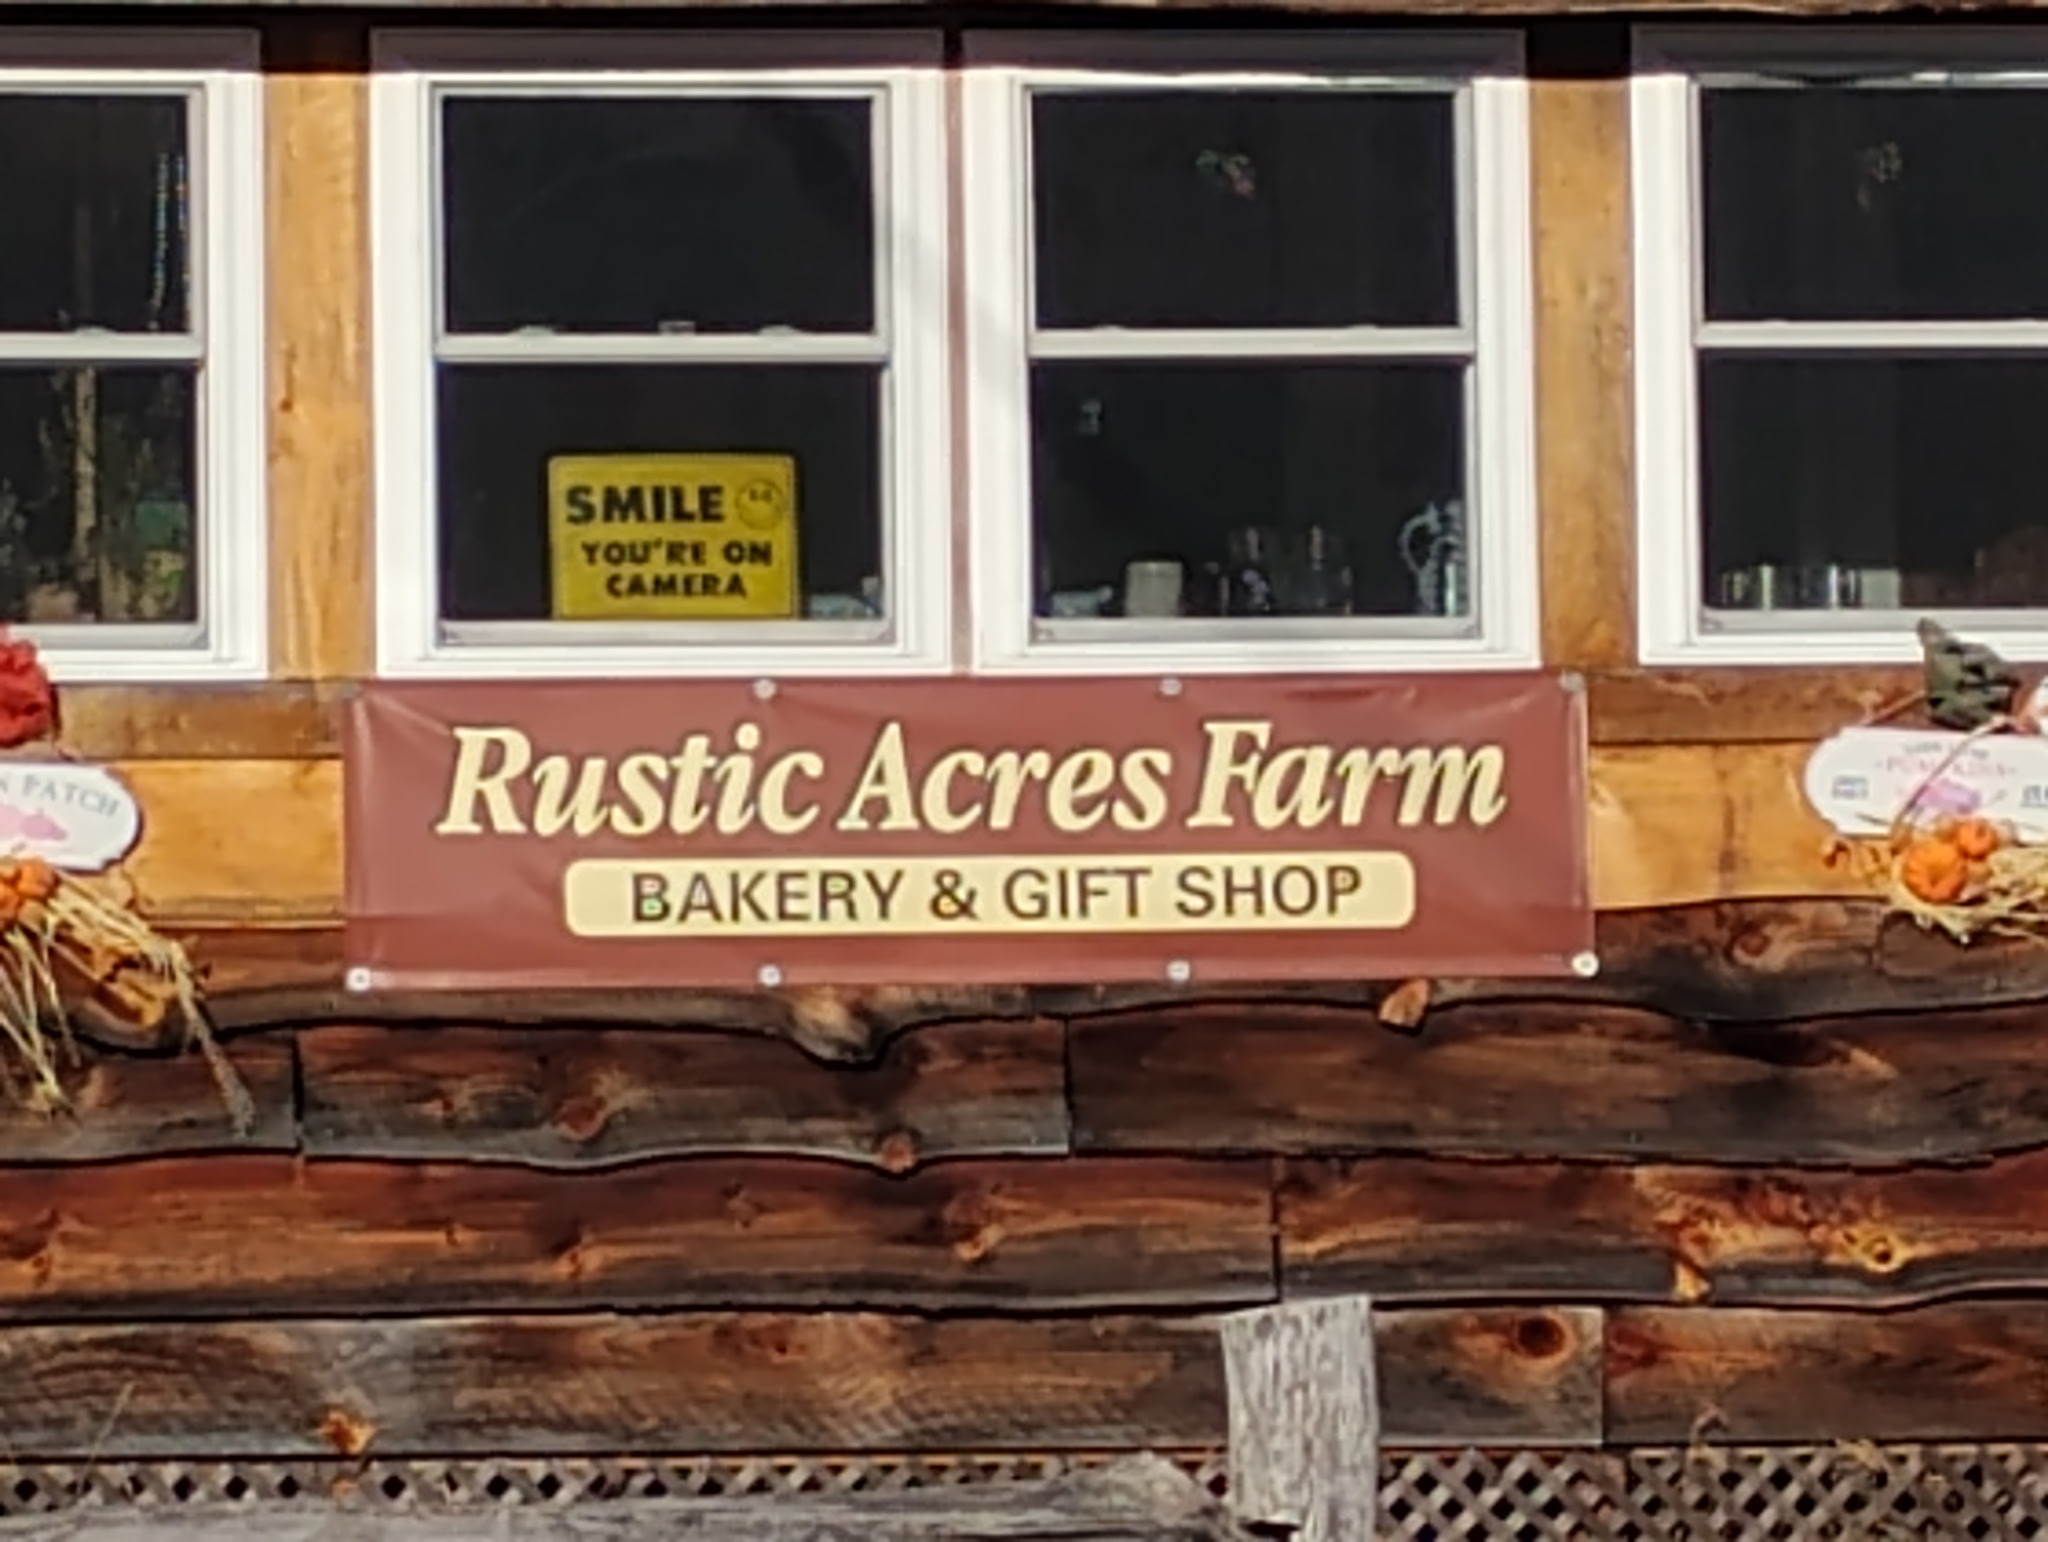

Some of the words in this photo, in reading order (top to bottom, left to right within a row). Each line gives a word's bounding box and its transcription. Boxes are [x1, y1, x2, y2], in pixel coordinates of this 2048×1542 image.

[566, 485, 724, 525] SMILE
[581, 538, 707, 566] YOU'RE
[722, 541, 772, 567] ON
[605, 573, 747, 598] CAMERA
[23, 773, 120, 817] PATCH
[435, 722, 825, 837] Rustic
[836, 721, 1173, 832] Acres
[1186, 720, 1508, 830] Farm
[631, 869, 905, 923] BAKERY
[929, 868, 981, 922] &
[1003, 866, 1152, 920] GIFT
[1175, 864, 1362, 918] SHOP
